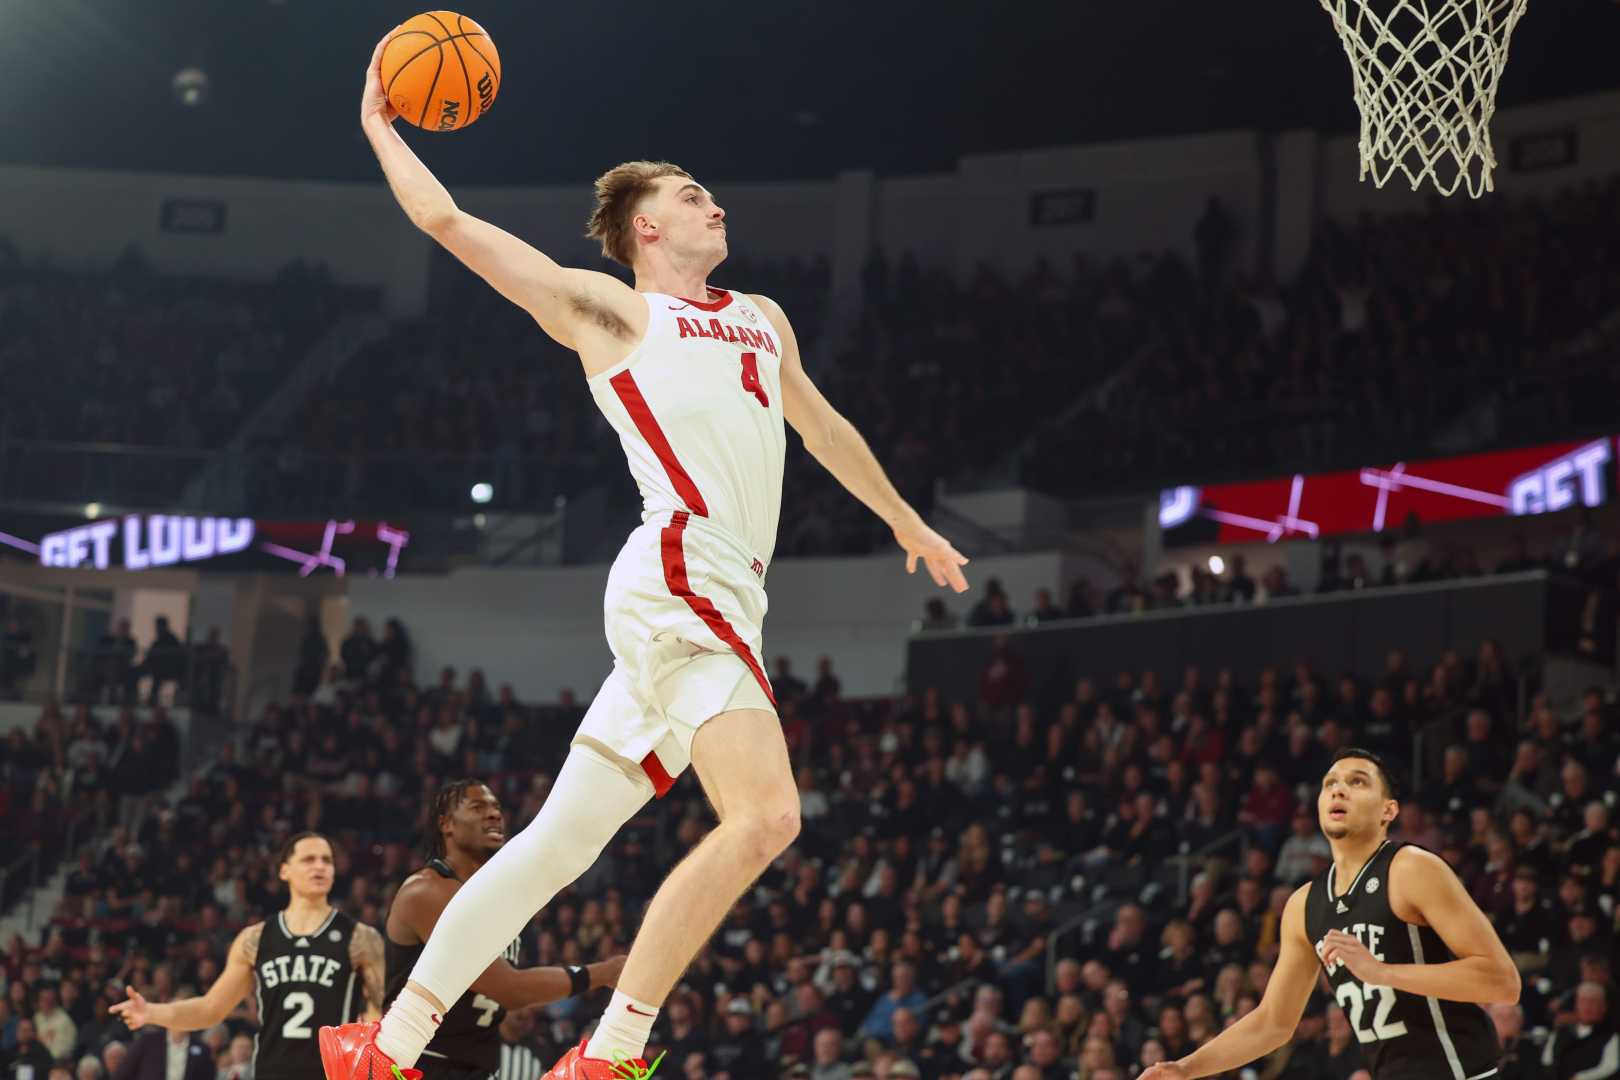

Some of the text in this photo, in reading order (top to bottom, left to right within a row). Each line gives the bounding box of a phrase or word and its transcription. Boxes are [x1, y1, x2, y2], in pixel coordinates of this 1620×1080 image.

[439, 99, 460, 129] NCA
[741, 352, 769, 408] 4
[261, 954, 342, 989] STATE
[1315, 923, 1385, 977] STE
[282, 991, 315, 1039] 2
[1335, 978, 1408, 1043] 22
